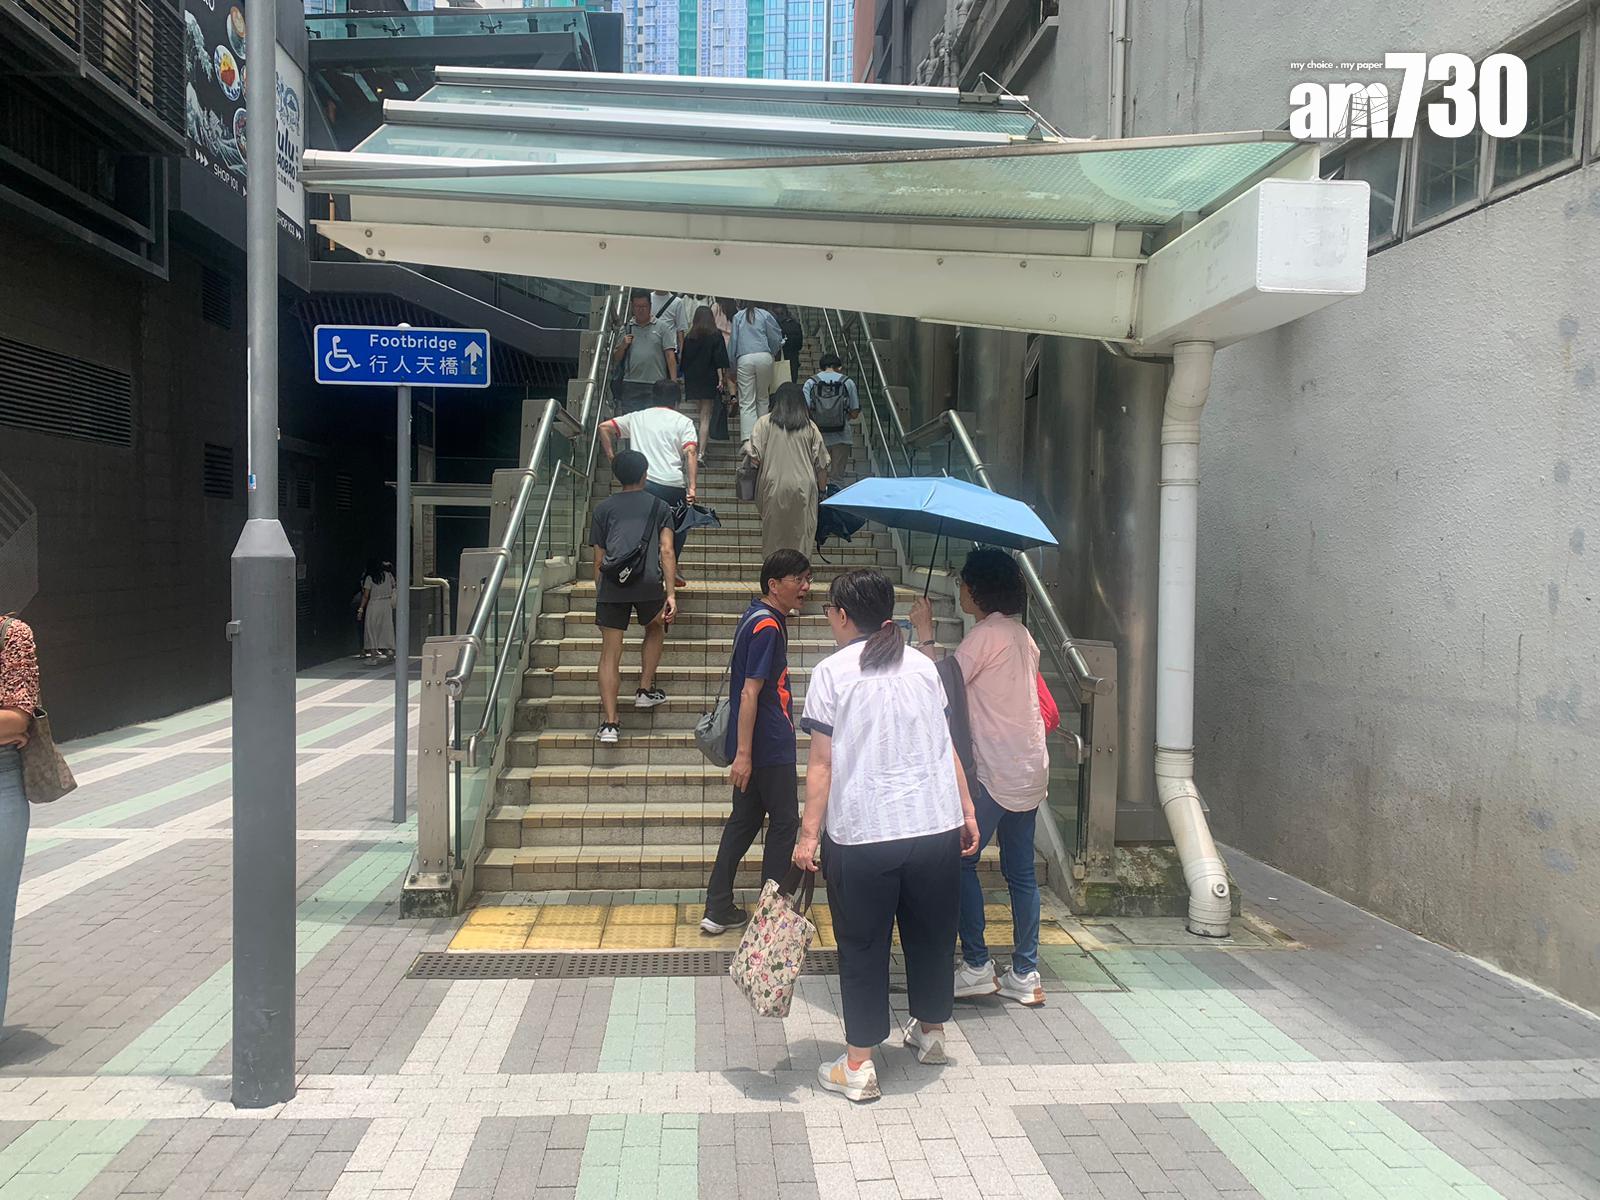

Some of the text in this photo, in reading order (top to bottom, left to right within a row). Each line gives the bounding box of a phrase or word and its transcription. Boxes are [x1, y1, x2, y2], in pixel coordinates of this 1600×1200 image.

[213, 163, 230, 183] SHOP
[369, 334, 457, 352] Footbridge
[369, 354, 459, 376] 行人天橋
